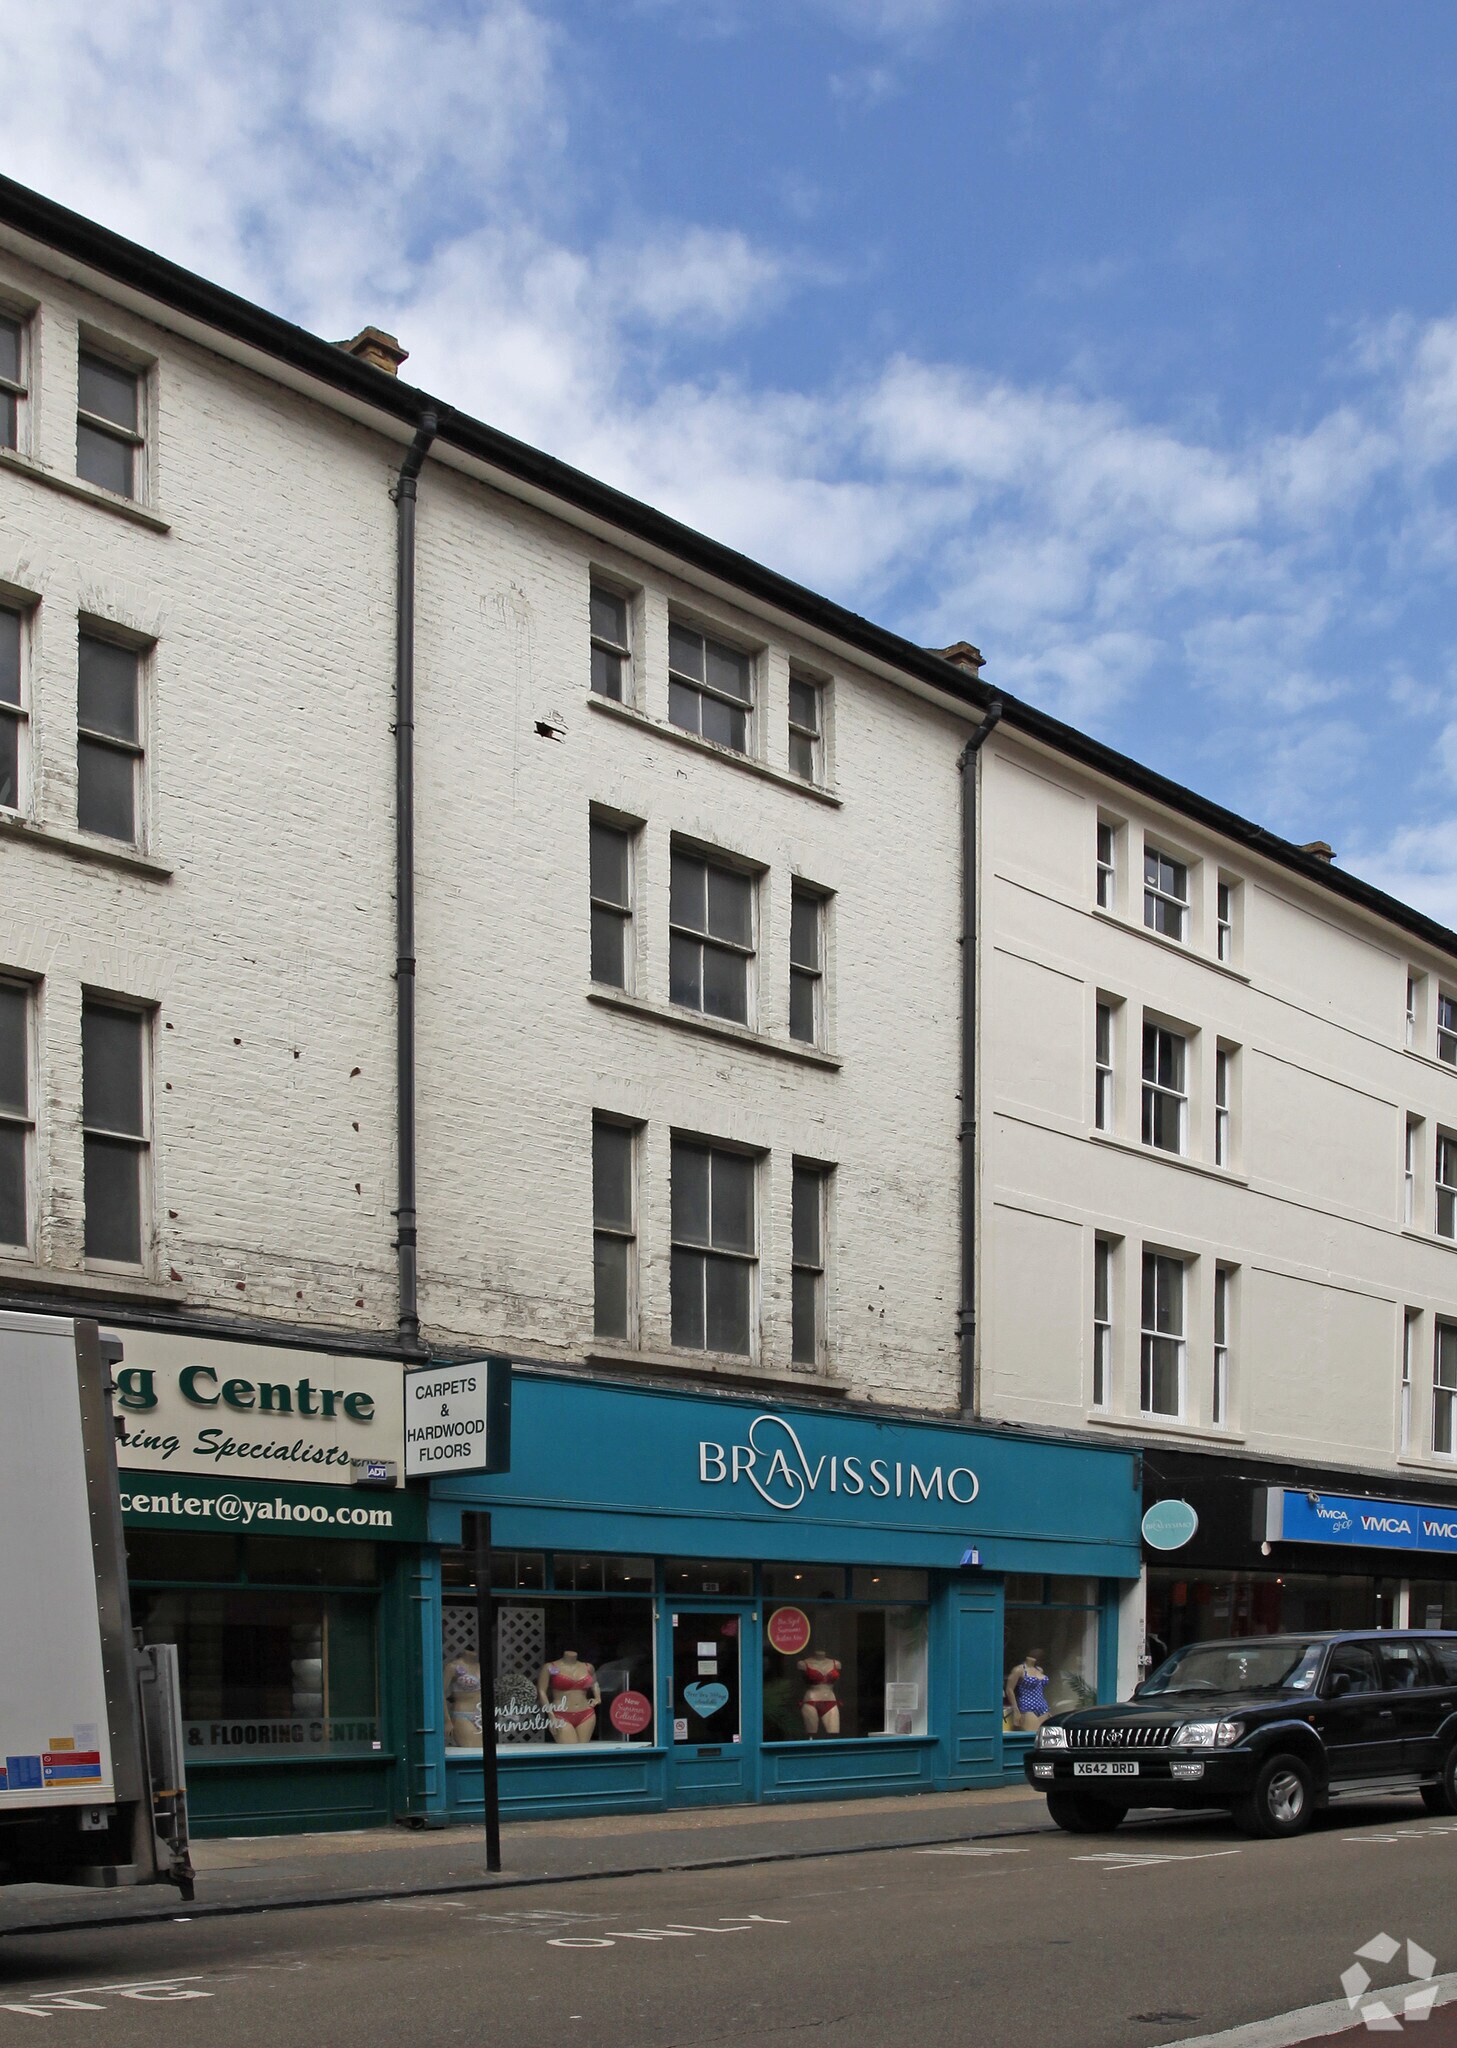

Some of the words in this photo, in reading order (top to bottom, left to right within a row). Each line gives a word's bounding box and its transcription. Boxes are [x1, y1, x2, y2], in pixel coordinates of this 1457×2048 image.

[179, 1365, 375, 1420] Centre
[415, 1378, 477, 1400] CARPETS
[441, 1403, 450, 1417] &
[407, 1420, 485, 1442] HARDWOOD
[193, 1429, 350, 1466] Specialists
[419, 1443, 472, 1462] FLOORS
[368, 1467, 386, 1477] ADT
[699, 1415, 979, 1509] BRAVISSIMO
[120, 1492, 393, 1527] center@yahoo.com
[542, 1695, 568, 1713] and
[211, 1723, 303, 1745] FLOORING
[1078, 1763, 1108, 1774] X642
[546, 1915, 790, 1947] ONLY
